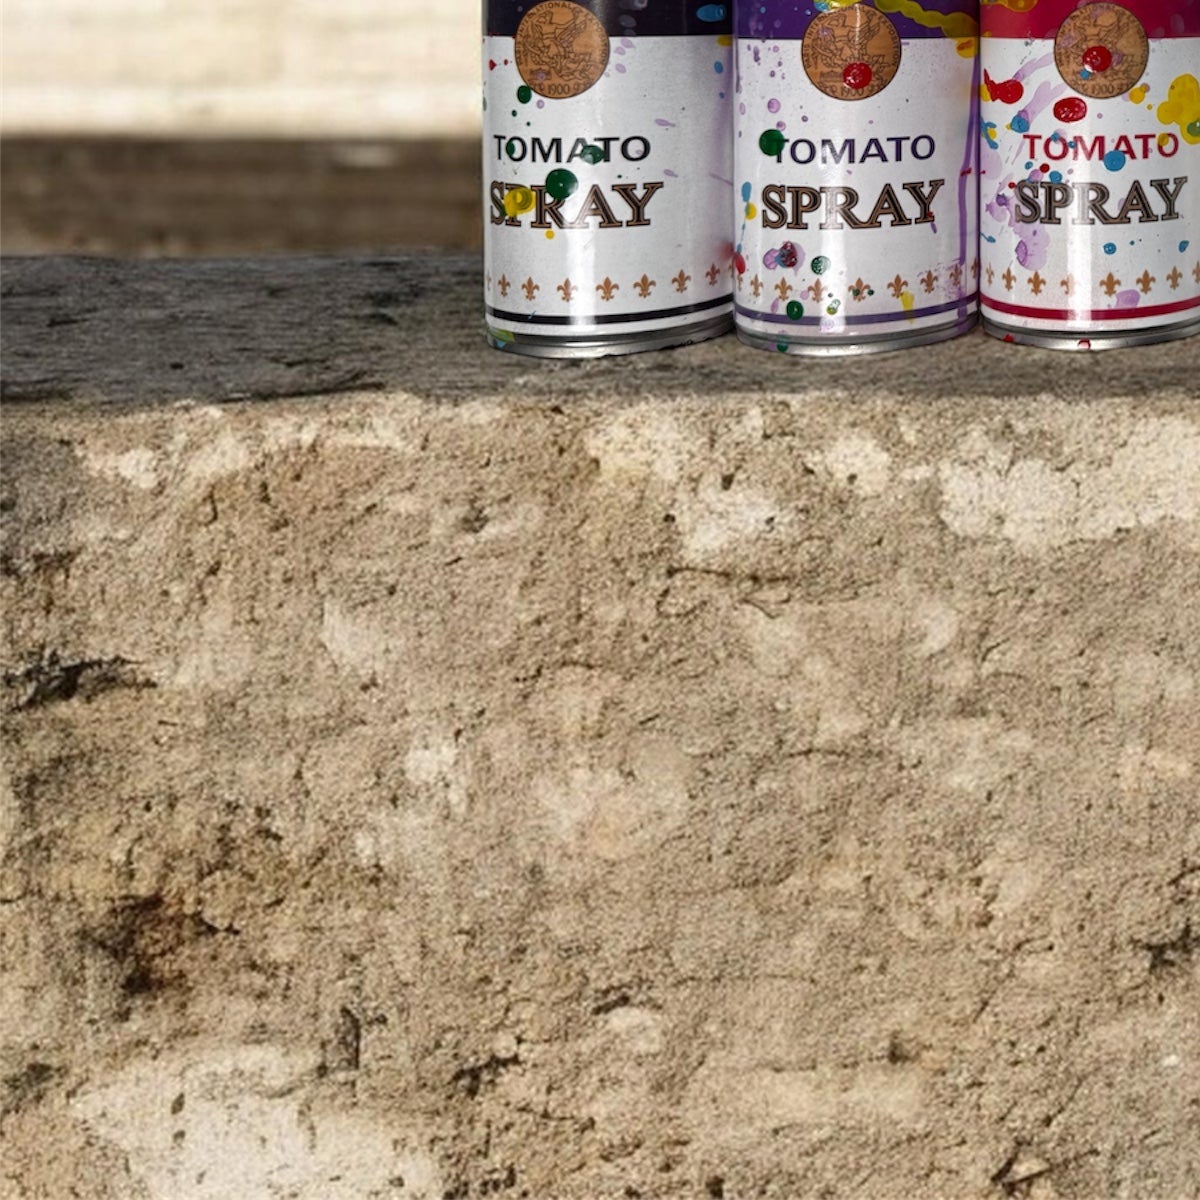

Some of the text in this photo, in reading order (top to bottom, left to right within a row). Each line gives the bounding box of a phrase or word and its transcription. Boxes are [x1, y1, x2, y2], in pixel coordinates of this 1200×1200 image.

[548, 83, 570, 95] 1900
[493, 134, 651, 163] TOMATO
[1023, 132, 1179, 161] TOMATO
[490, 180, 664, 229] SPRAY
[762, 179, 944, 230] SPRAY
[1015, 176, 1188, 225] SPRAY
